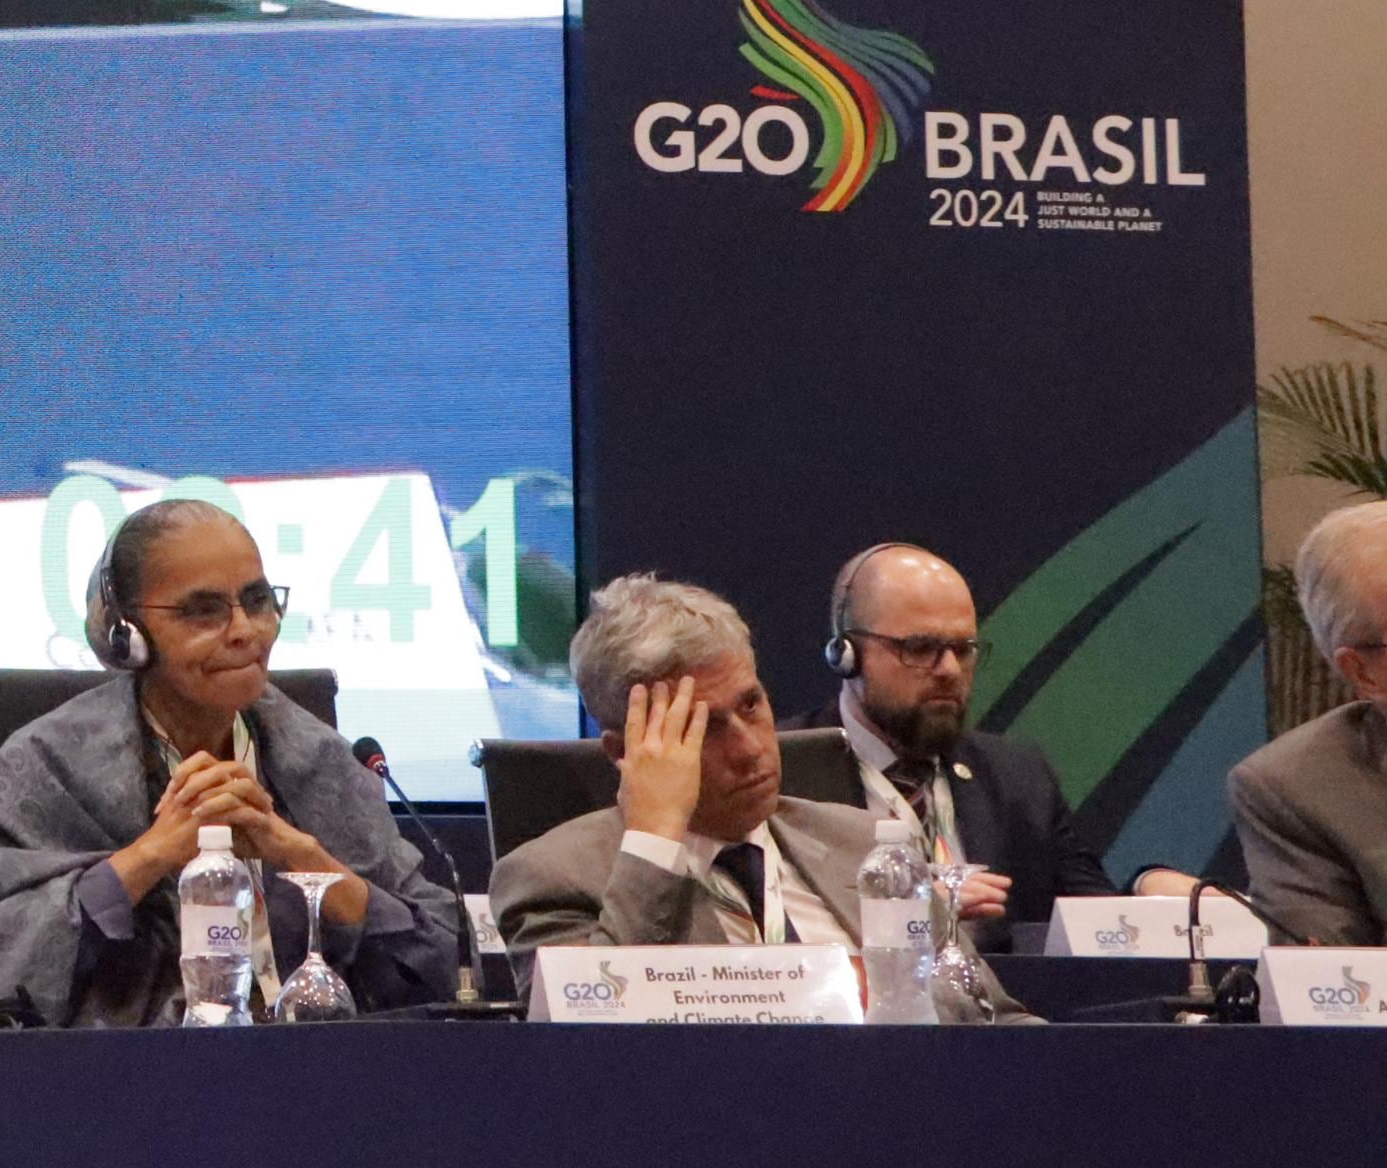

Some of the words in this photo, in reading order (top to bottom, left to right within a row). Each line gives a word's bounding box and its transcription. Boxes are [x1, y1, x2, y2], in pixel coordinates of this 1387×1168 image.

[634, 101, 810, 176] G20
[924, 111, 1206, 186] BRASIL
[1037, 190, 1093, 203] BUILDING
[1095, 192, 1105, 203] A
[929, 188, 1029, 228] 2024
[1037, 205, 1065, 216] JUST
[1068, 206, 1112, 217] WORLD
[1113, 207, 1140, 218] AND
[1142, 208, 1152, 218] A
[1037, 219, 1115, 231] SUSTAINABLE
[1117, 220, 1164, 232] PLANET
[207, 925, 242, 940] G20
[1094, 930, 1129, 944] G20
[645, 966, 696, 982] Brazil
[712, 966, 782, 981] Minister
[787, 964, 805, 981] of
[563, 983, 612, 1001] G20
[673, 990, 786, 1005] Environment
[1308, 986, 1356, 1005] G20
[646, 1013, 678, 1023] and
[684, 1012, 752, 1023] Climate
